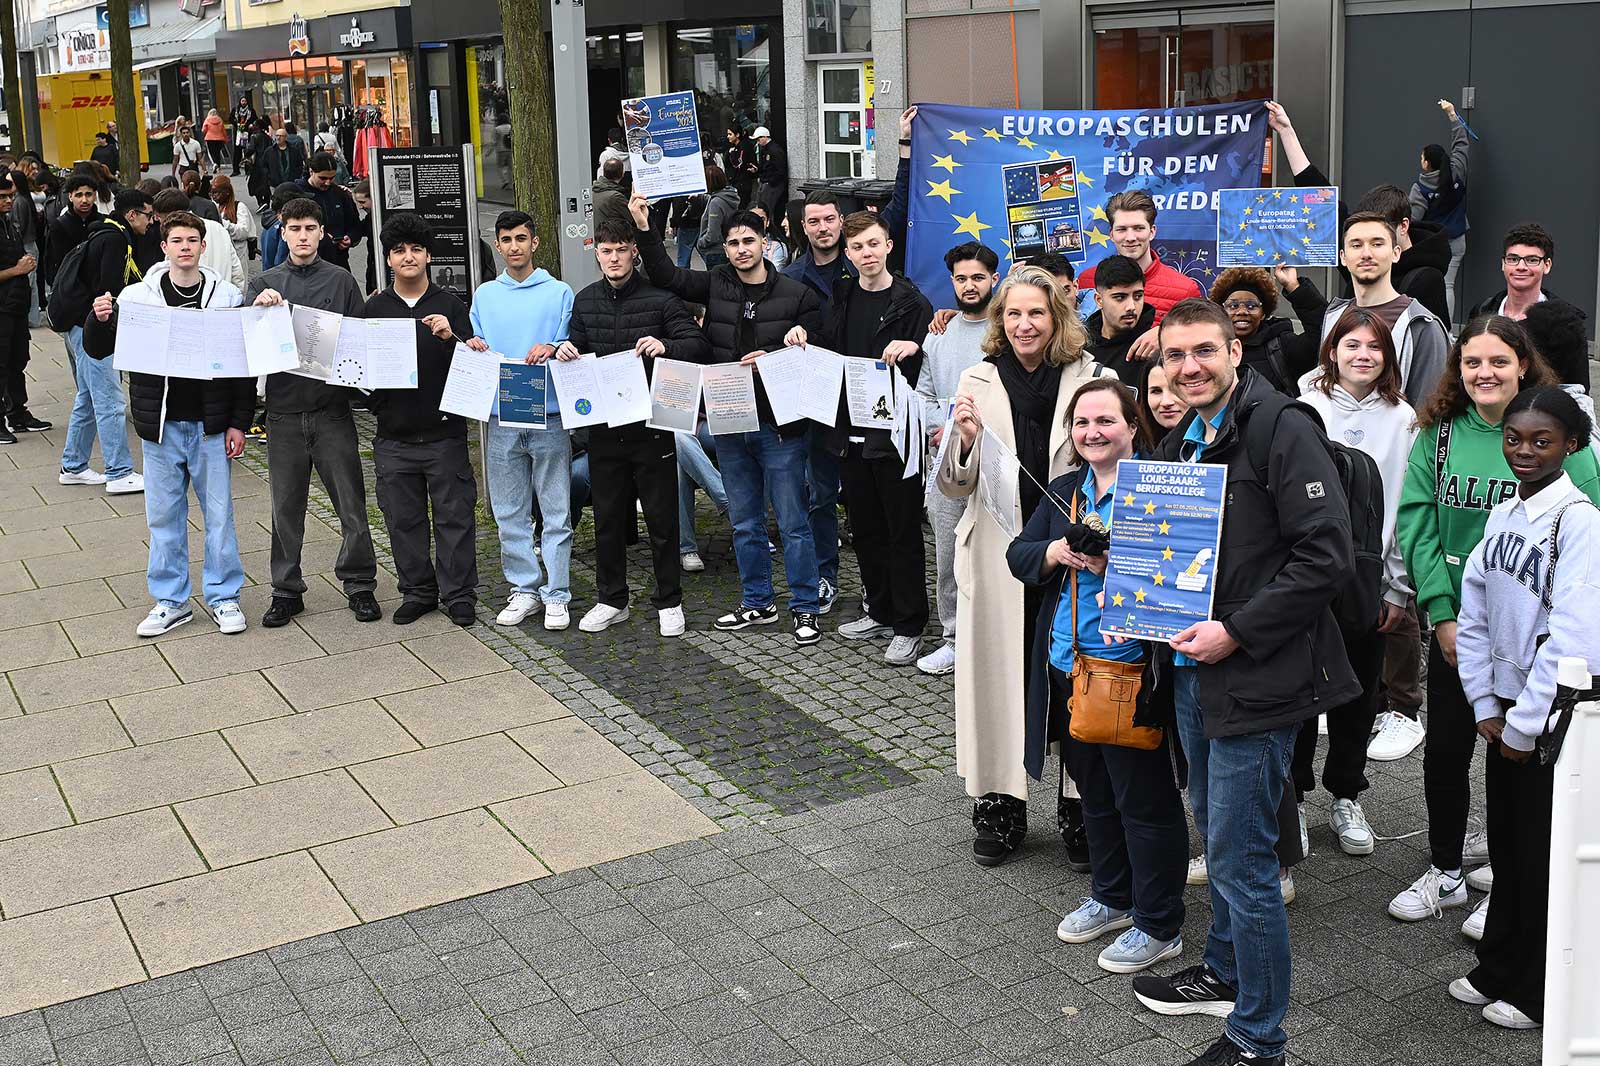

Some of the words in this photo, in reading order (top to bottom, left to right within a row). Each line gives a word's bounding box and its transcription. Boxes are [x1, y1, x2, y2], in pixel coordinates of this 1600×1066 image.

[880, 80, 891, 94] 27
[71, 95, 115, 108] DH
[1002, 113, 1252, 137] EUROPASCHULEN
[1103, 151, 1155, 176] FÜR
[1164, 153, 1219, 176] DEN
[1152, 191, 1219, 210] RIEDE
[1440, 422, 1449, 438] FILA
[1438, 446, 1446, 463] FILA
[1138, 464, 1191, 476] EUROPATAG
[1192, 467, 1208, 477] AM
[1141, 475, 1202, 487] LOUIS-BAARE-
[1135, 484, 1206, 497] BERUFSKOLLEGE
[1439, 472, 1518, 511] ALIB
